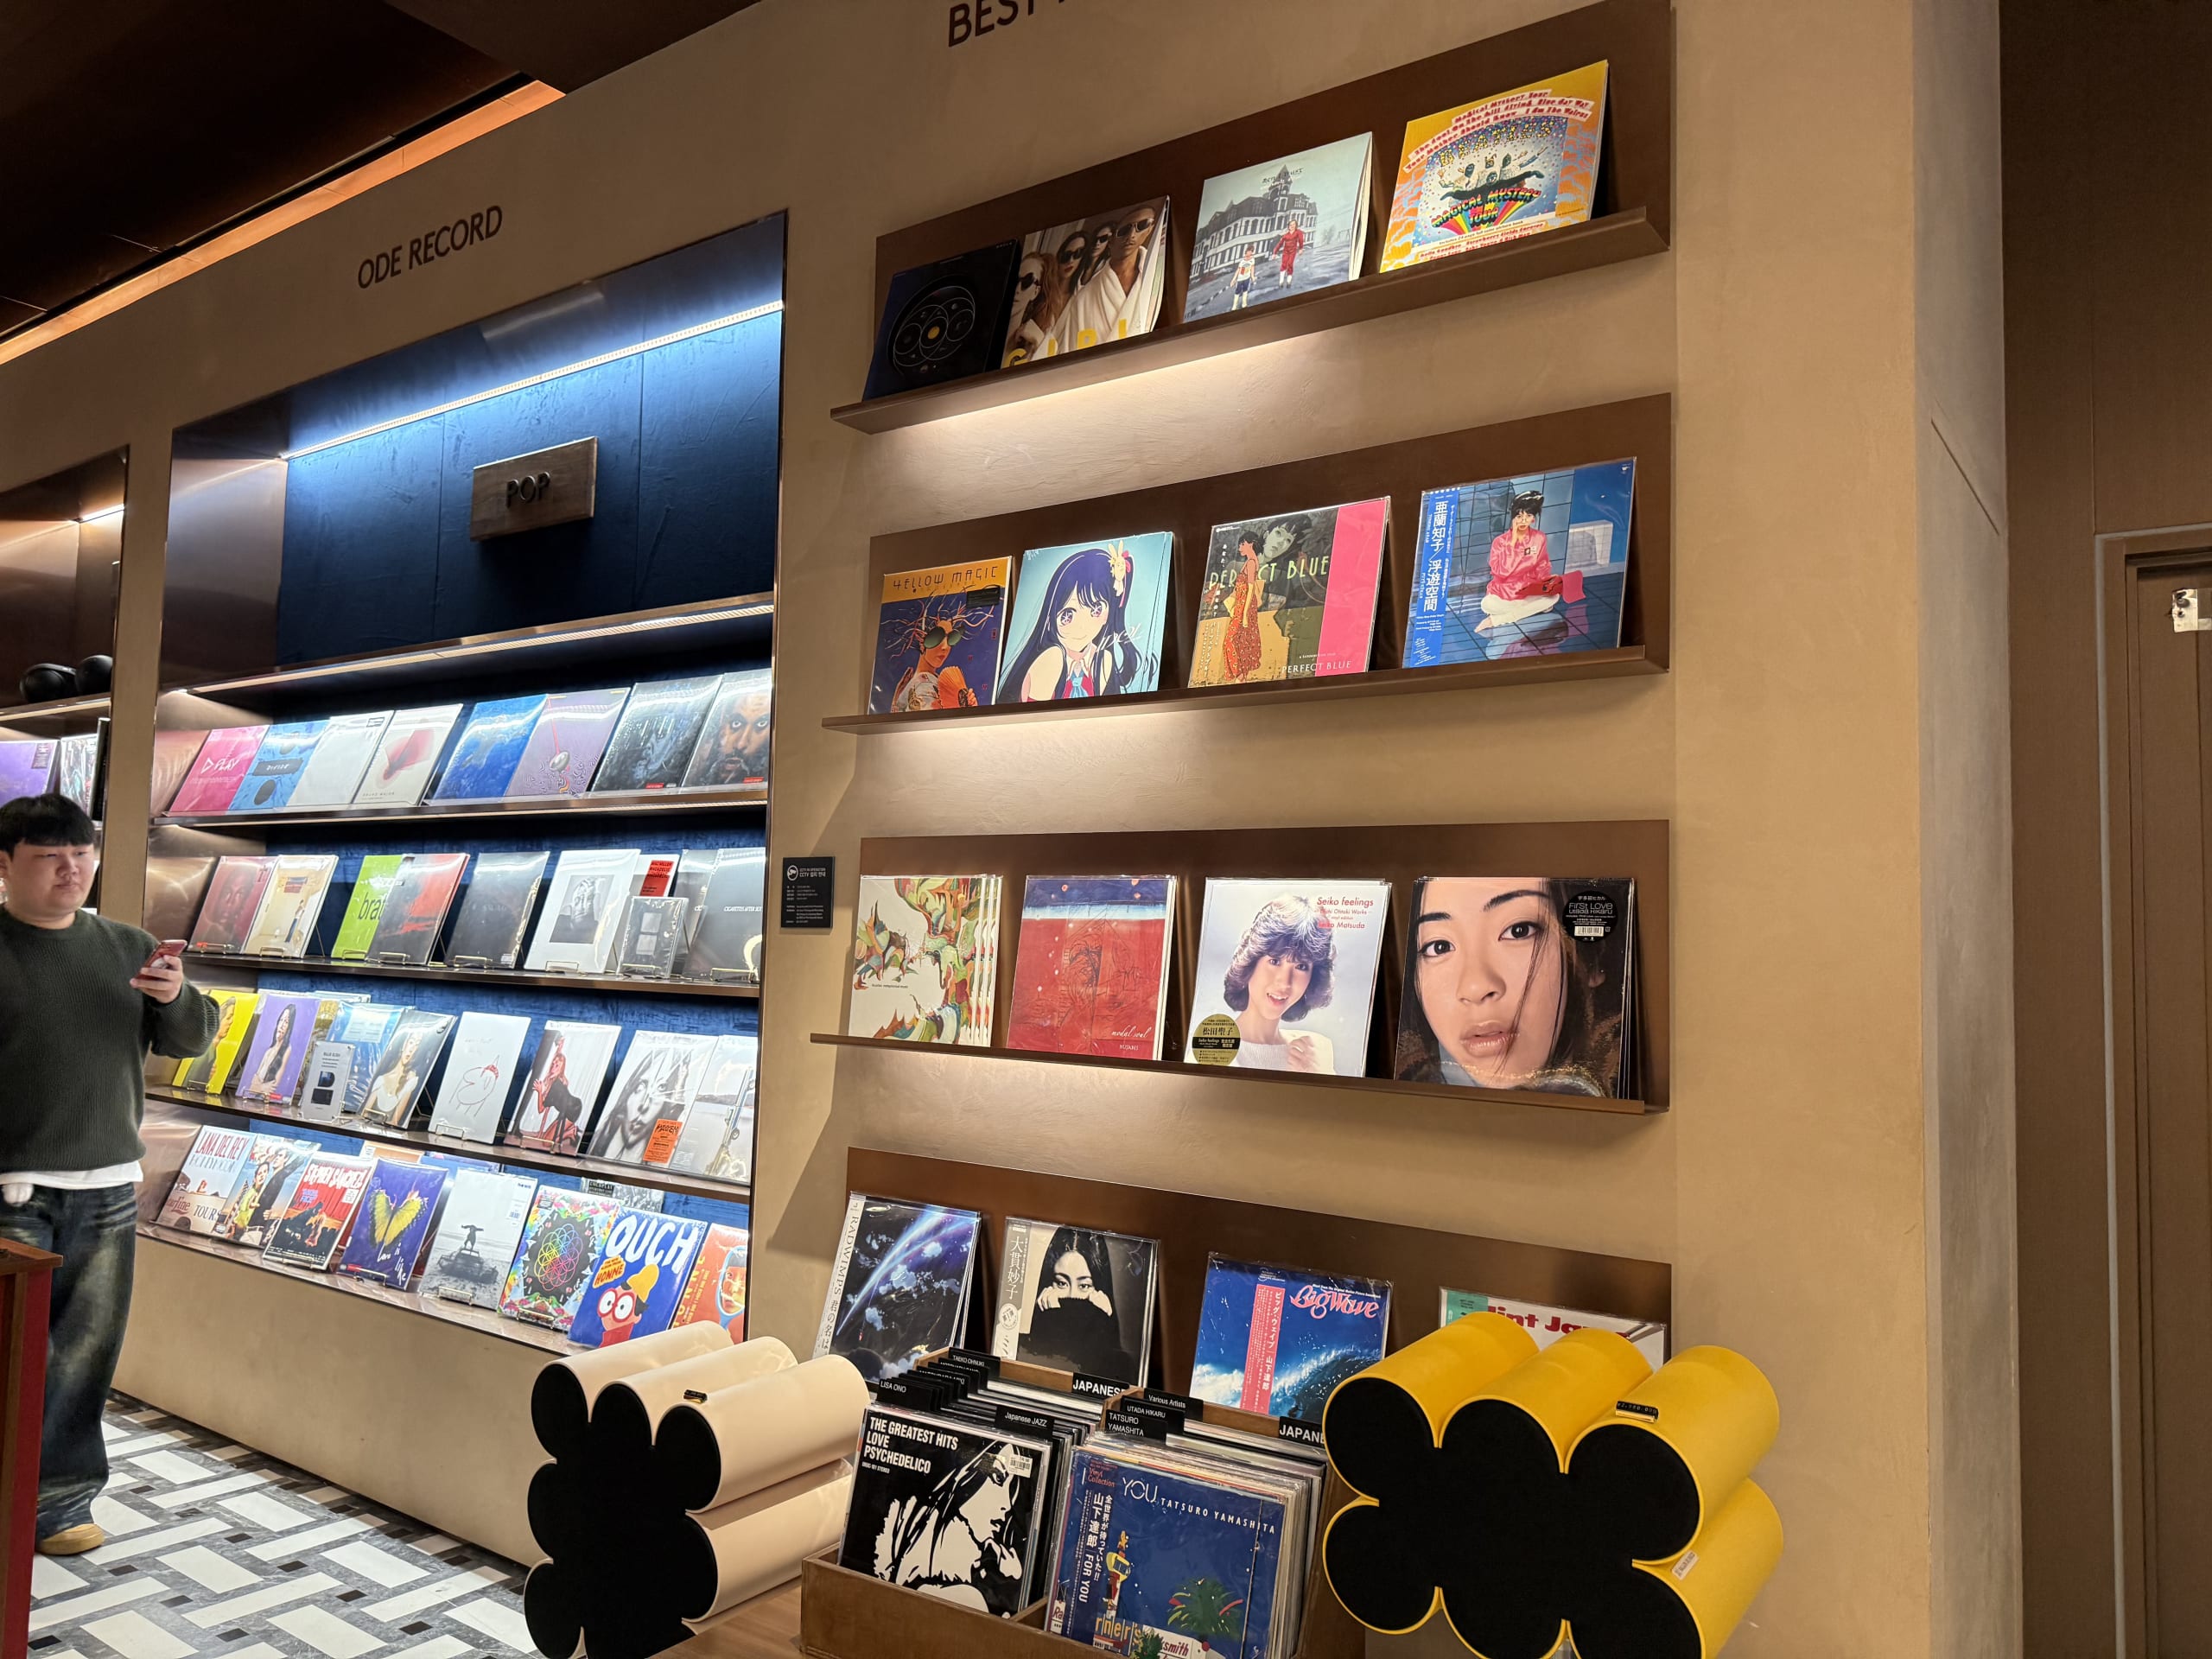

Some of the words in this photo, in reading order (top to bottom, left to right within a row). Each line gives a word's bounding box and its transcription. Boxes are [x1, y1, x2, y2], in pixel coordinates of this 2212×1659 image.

[1487, 188, 1542, 205] MYSTERY
[1431, 194, 1484, 228] MAGICAL
[1468, 207, 1499, 228] TOUR
[358, 245, 403, 289] ODE
[409, 206, 503, 270] RECORD
[505, 472, 550, 509] POP
[893, 573, 944, 590] YELLOW
[951, 566, 998, 583] MAGIC
[1209, 563, 1277, 590] PERCT
[1287, 556, 1329, 580] BLUE
[1281, 663, 1323, 674] PERFECT
[1326, 660, 1351, 671] BLUE
[1317, 896, 1339, 906] Seiko
[1341, 896, 1374, 908] feelings
[1111, 1025, 1136, 1037] modal
[1134, 1026, 1152, 1038] soul
[195, 1131, 220, 1156] LANA
[214, 1134, 233, 1158] DEL
[227, 1135, 250, 1160] REY
[606, 1214, 699, 1274] OUCH
[834, 1216, 859, 1295] RADWIMPS
[595, 1264, 623, 1286] HONNE
[1005, 1236, 1024, 1300] 大貫妙子
[1262, 1357, 1273, 1390] 山下達郎
[880, 1381, 892, 1389] LISA
[893, 1384, 906, 1393] ONO
[1072, 1380, 1125, 1397] JAPANES
[1127, 1406, 1145, 1414] UTADA
[1145, 1408, 1166, 1419] HIKARU
[1148, 1395, 1168, 1405] Various
[1169, 1398, 1186, 1408] Artists
[1005, 1411, 1030, 1424] Japanese
[1031, 1416, 1048, 1427] JAZZ
[1108, 1423, 1145, 1437] YAMASHITA
[1109, 1413, 1139, 1425] TATSURO
[866, 1431, 890, 1448] LOVE
[870, 1417, 887, 1432] THE
[888, 1421, 935, 1445] GREATEST
[936, 1432, 959, 1451] HITS
[863, 1446, 931, 1474] PSYCHEDELICO
[1087, 1475, 1116, 1488] Collection
[1089, 1468, 1103, 1478] Vinyl
[1122, 1477, 1159, 1503] YOU
[1086, 1492, 1104, 1548] 山下達郎
[1160, 1497, 1209, 1516] TATSURO
[1213, 1510, 1275, 1535] YAMASHITA
[1084, 1554, 1094, 1576] FOR
[1078, 1578, 1090, 1603] YOU
